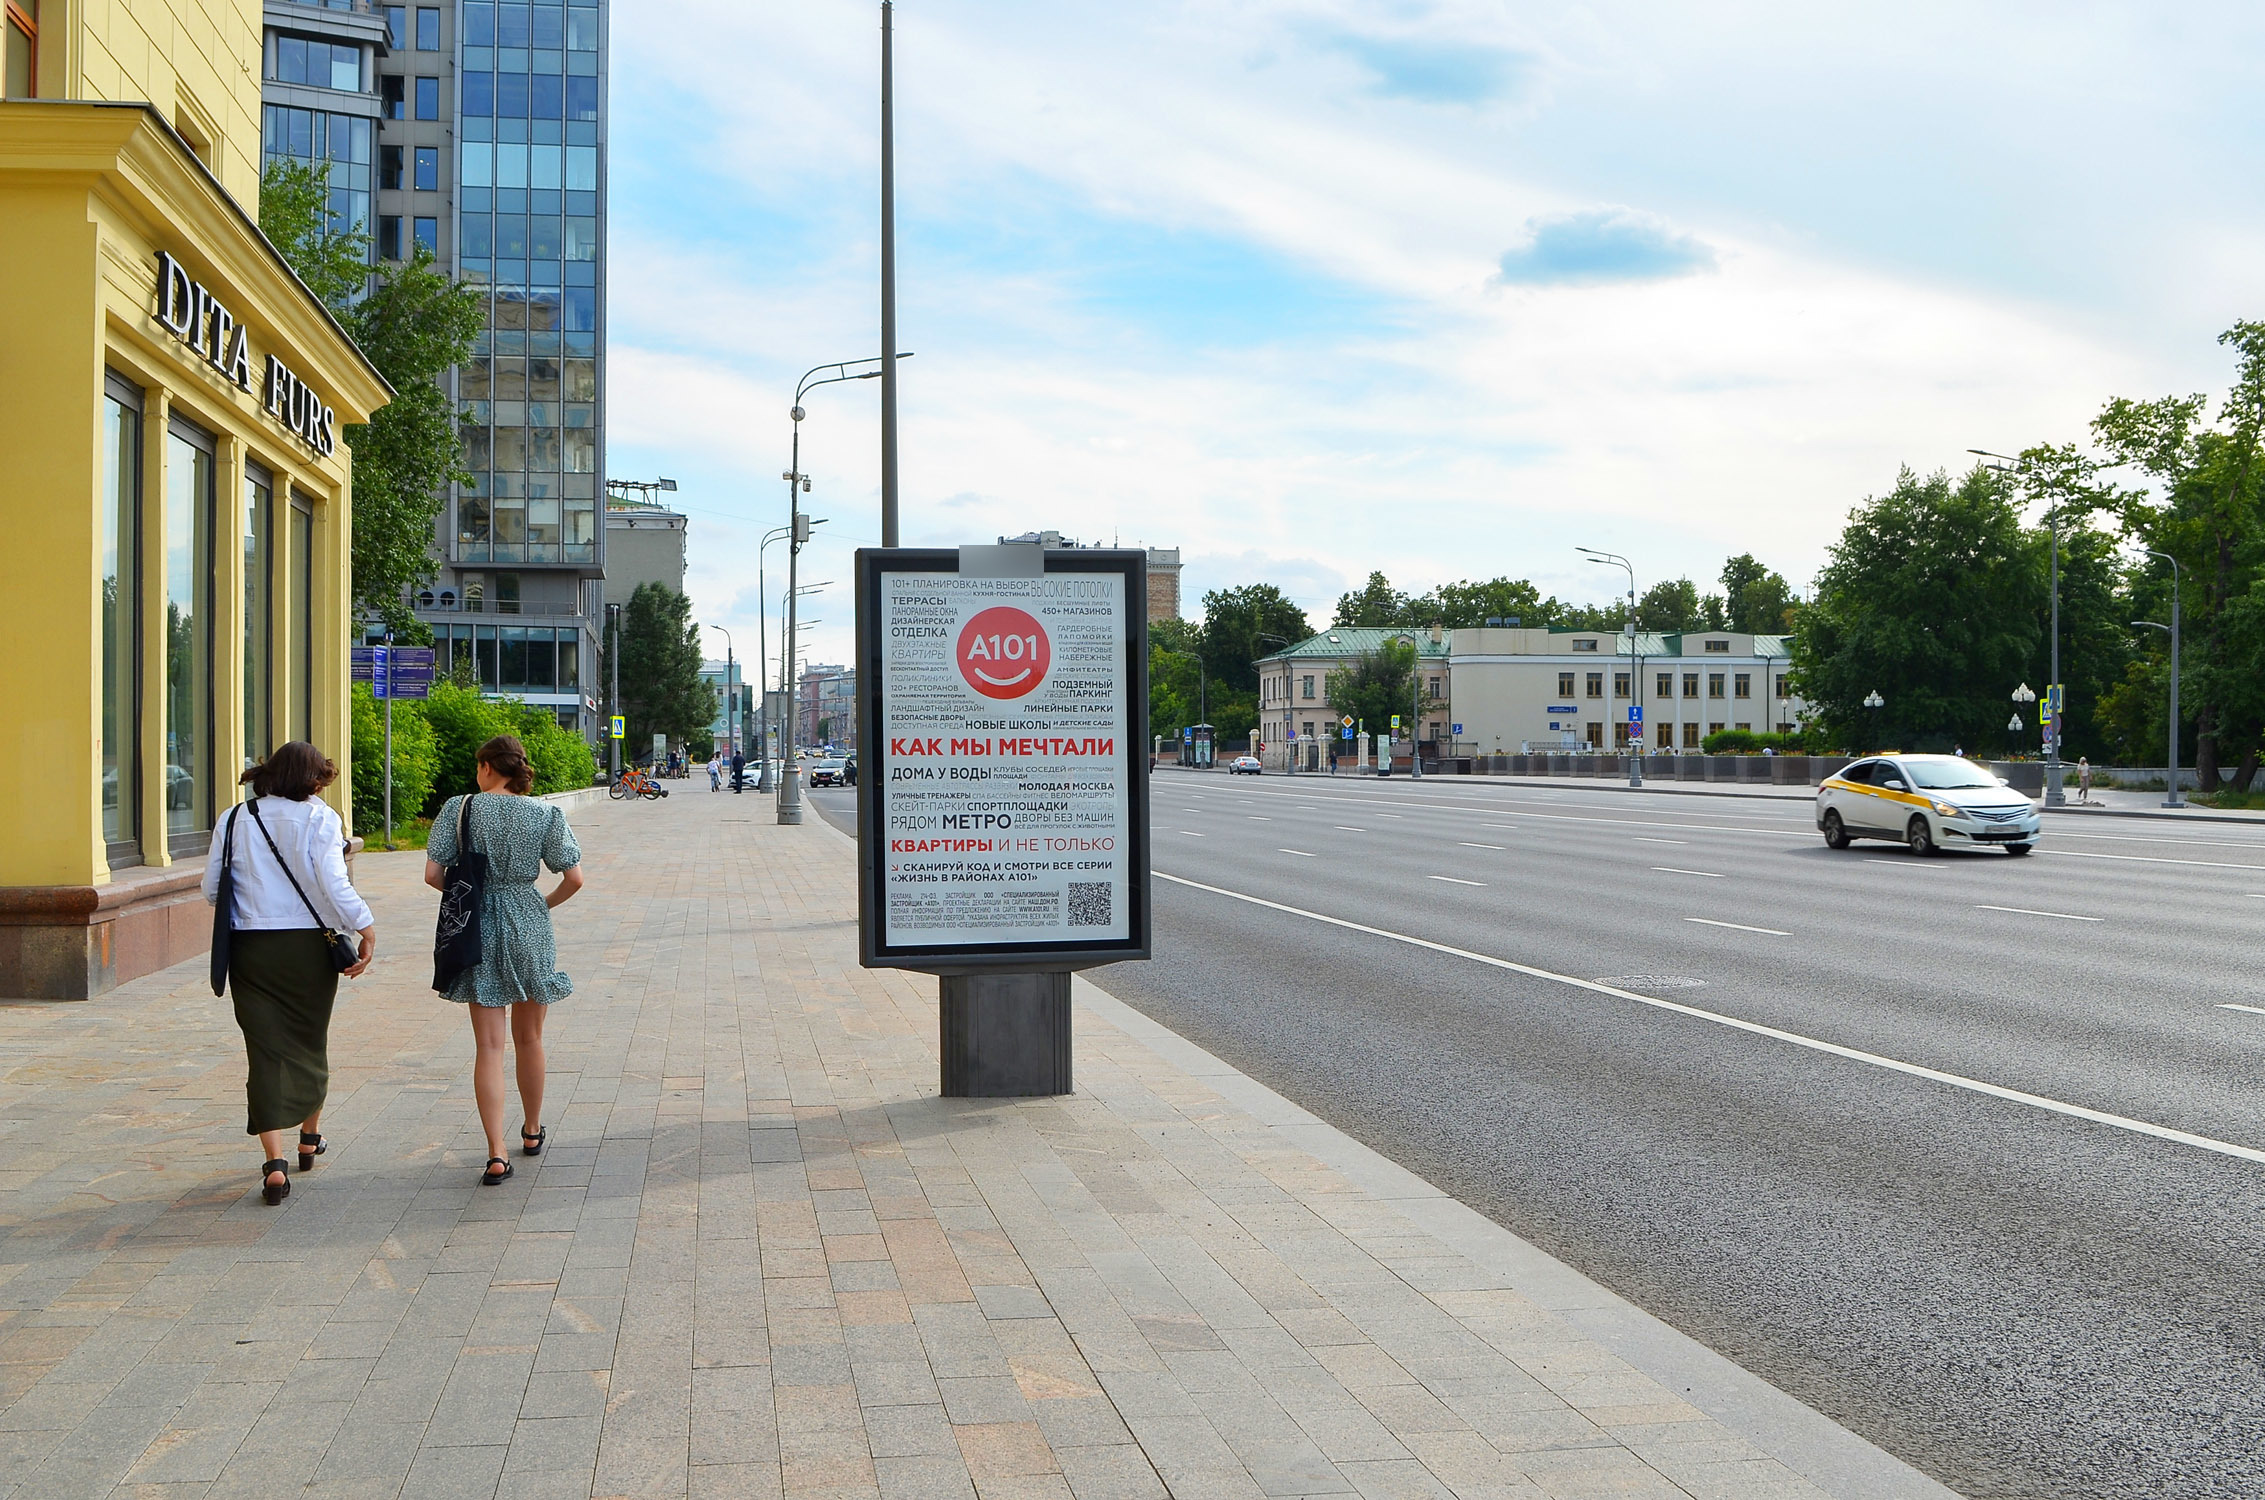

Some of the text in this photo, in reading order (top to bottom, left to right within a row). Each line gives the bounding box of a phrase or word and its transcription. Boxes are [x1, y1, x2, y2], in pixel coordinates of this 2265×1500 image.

[153, 250, 334, 457] DITA FURS
[892, 580, 1029, 590] 101+ ПЛАНИРОВКА НА ВЫБОР
[1031, 580, 1112, 598] ВЫСОКИЕ ПОТОЛКИ
[892, 597, 947, 605] ТЕРРАСЫ
[892, 607, 958, 616] ПАНОРАМНЫЕ ОКНА
[891, 616, 955, 625] ДИЗАЙНЕРСКАЯ
[892, 627, 948, 638] ОТДЕЛКА
[891, 650, 946, 659] КВАРТИРЫ
[1053, 679, 1112, 689] ПОДЗЕМНЫЙ
[1024, 704, 1078, 712] ЛИНЕЙНЫЕ
[966, 721, 1051, 729] НОВЫЕ ШКОЛЫ
[891, 738, 1113, 756] КАК МЫ МЕЧТАЛИ
[892, 768, 991, 781] ДОМА У ВОДЫ
[1019, 783, 1070, 791] МОЛОДАЯ
[891, 801, 1068, 811] СКЕЙТ-ПАРКИ СПОРТПЛОЩАДКИ
[891, 814, 1011, 831] РЯДОМ МЕТРО
[1014, 814, 1051, 823] ДВОРЫ
[891, 839, 992, 852] КВАРТИРЫ
[999, 838, 1009, 851] И
[1016, 838, 1039, 851] НЕ
[904, 861, 963, 871] СКАНИРУЙ
[967, 863, 990, 872] КОД
[994, 863, 1001, 871] И
[1005, 862, 1049, 870] СМОТРИ
[891, 874, 938, 882] «ЖИЗНЬ
[952, 872, 1004, 881] РАЙОНАХ
